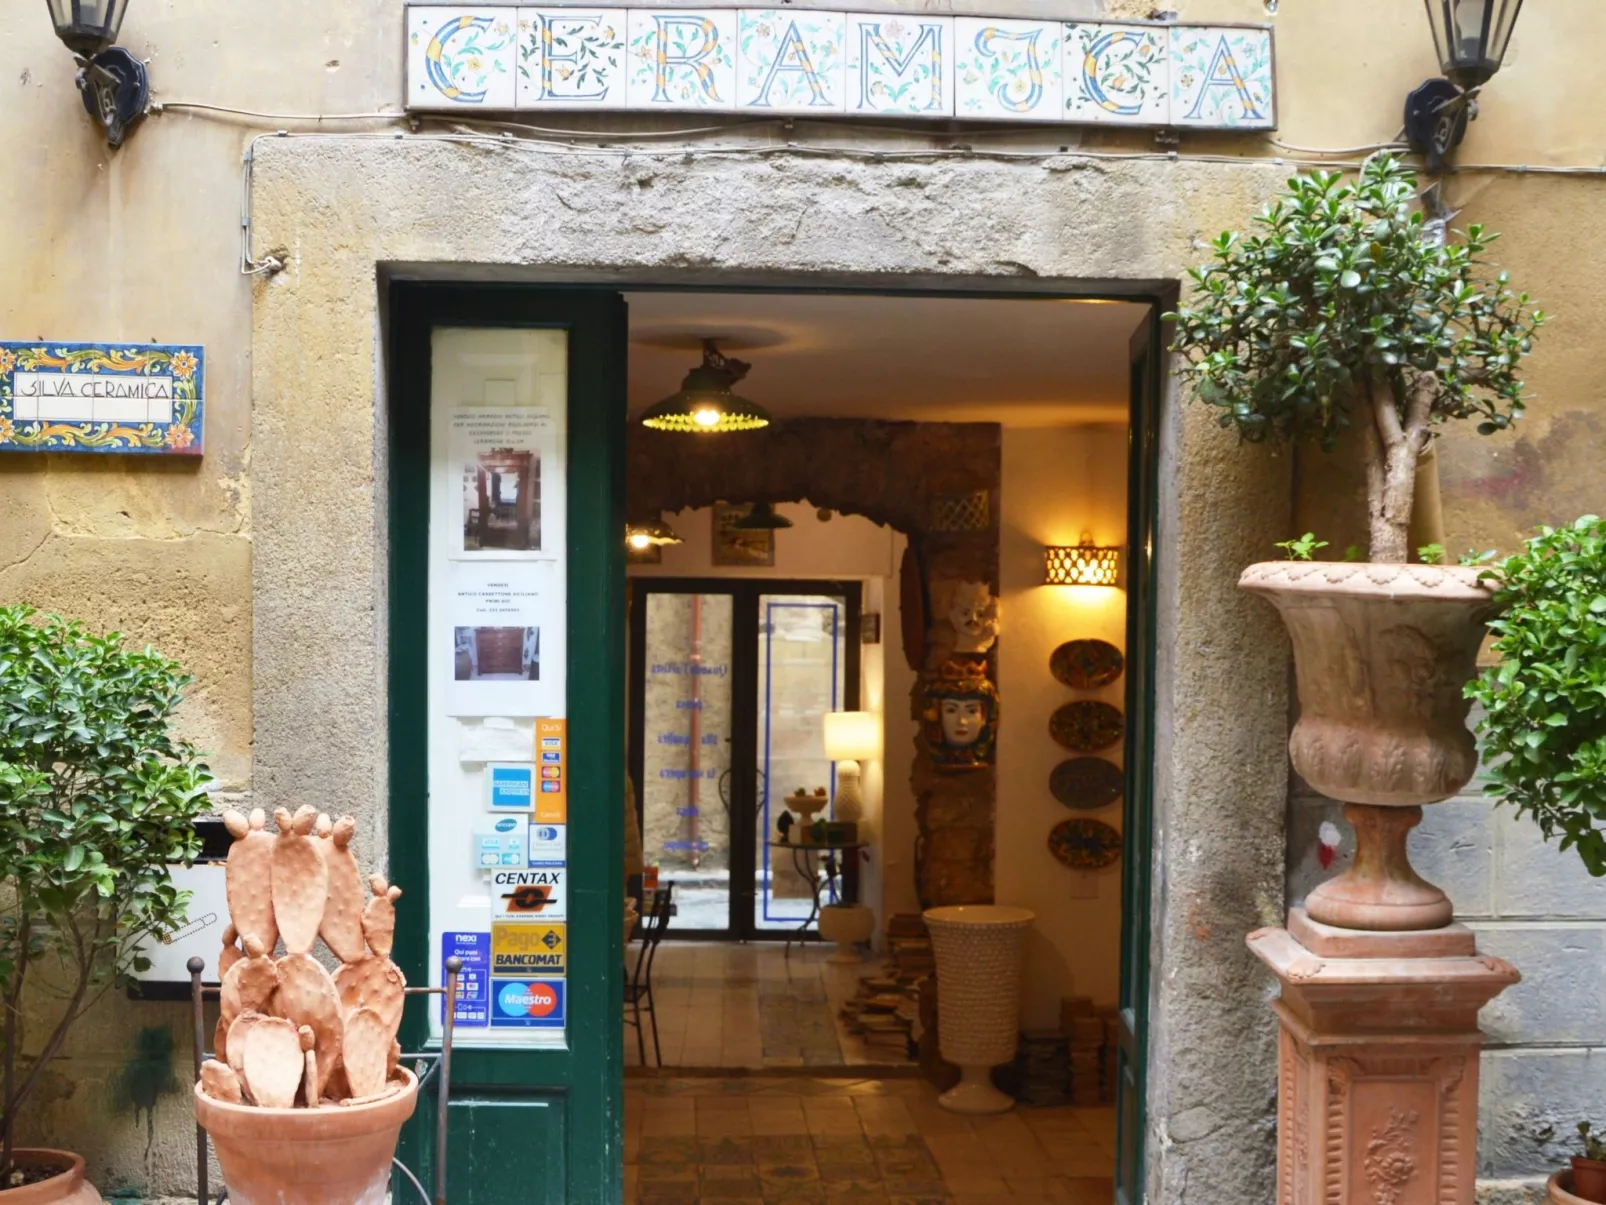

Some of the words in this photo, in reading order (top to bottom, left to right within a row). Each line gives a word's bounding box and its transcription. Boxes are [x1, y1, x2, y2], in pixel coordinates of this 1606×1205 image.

[21, 377, 75, 397] SILVA
[80, 379, 169, 399] CERAMICA
[493, 780, 529, 788] AMERICAN
[495, 872, 561, 885] CENTAX
[455, 934, 477, 942] nexi
[495, 927, 540, 950] Pago
[495, 954, 562, 965] BANCOMAT
[504, 993, 552, 1005] Maestro
